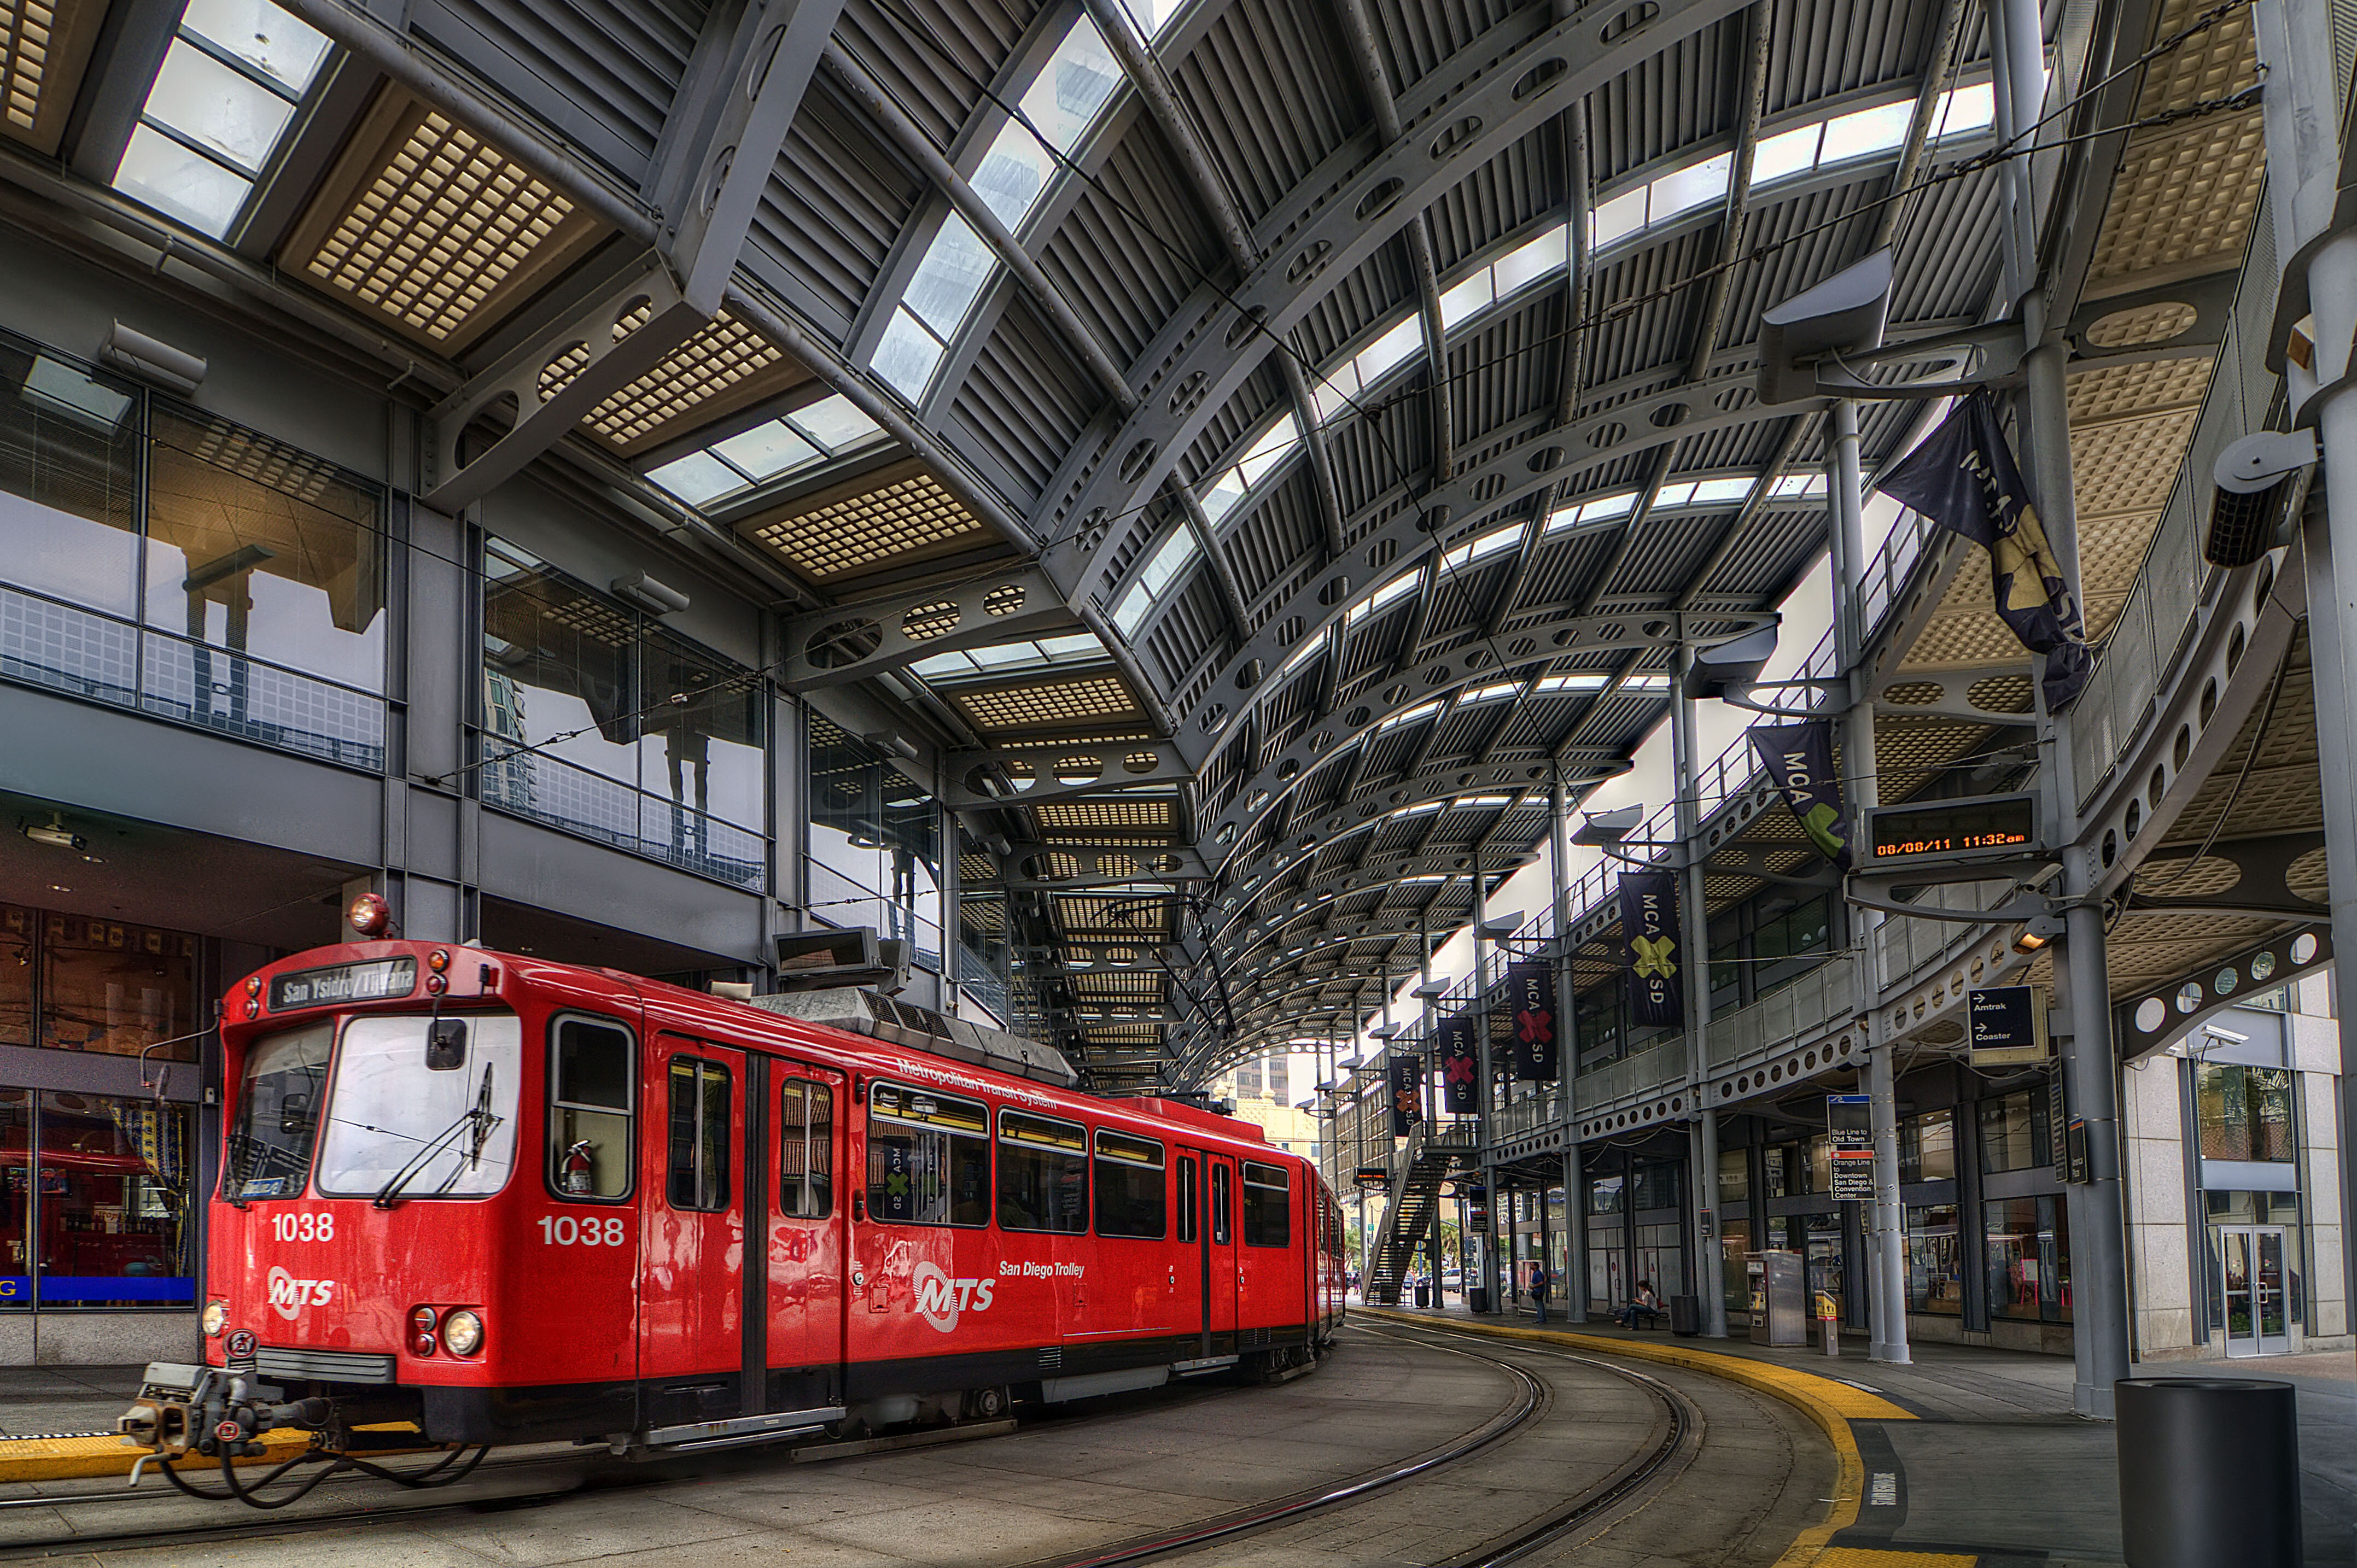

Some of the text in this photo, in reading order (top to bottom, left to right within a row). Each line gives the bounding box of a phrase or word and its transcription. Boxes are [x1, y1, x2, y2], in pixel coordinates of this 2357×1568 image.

[1784, 752, 1813, 805] MCA
[1877, 834, 2025, 856] 08/08/11 11:32am
[1643, 894, 1664, 1004] MCA SD
[283, 982, 308, 1003] San
[1974, 1003, 2006, 1011] Amtrak
[1526, 979, 1543, 1063] MCA SD
[1402, 1068, 1411, 1090] MCA
[1452, 1031, 1467, 1100] MCA SD
[896, 1058, 1058, 1110] Metropolitan Transit System
[271, 1213, 335, 1242] 1038
[537, 1215, 625, 1247] 1038
[999, 1260, 1085, 1279] San Diego Trolley
[267, 1279, 336, 1306] MTS
[914, 1278, 996, 1313] MTS
